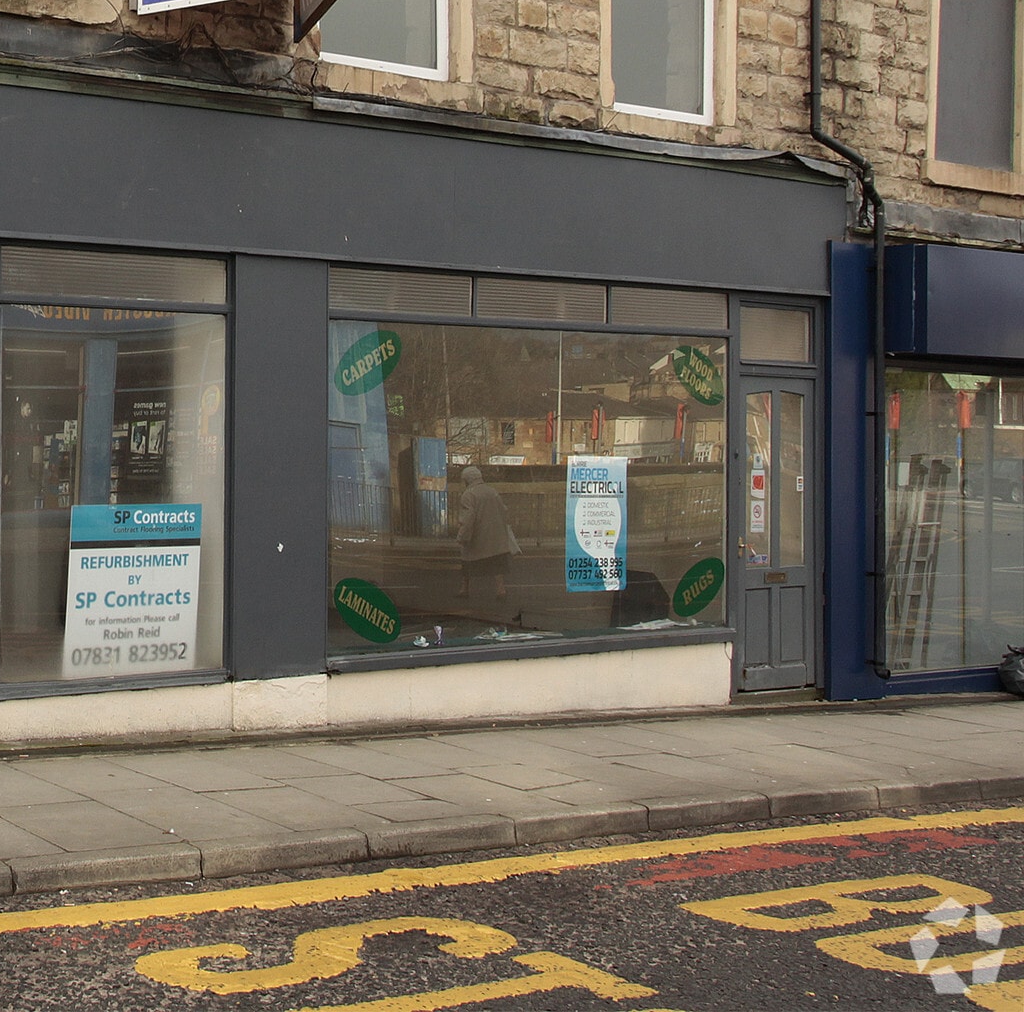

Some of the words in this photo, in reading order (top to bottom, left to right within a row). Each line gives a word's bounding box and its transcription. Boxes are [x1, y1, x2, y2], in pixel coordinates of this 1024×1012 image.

[342, 339, 396, 386] CARPETS
[689, 354, 713, 381] WOOD
[681, 365, 712, 399] FLOORS
[571, 468, 608, 481] MERCER
[114, 510, 131, 524] SP
[133, 509, 195, 524] Contracts
[141, 525, 164, 533] Flooring
[80, 554, 189, 569] REFURBISHMENT
[568, 558, 593, 569] 01254
[594, 557, 609, 568] 238
[128, 575, 142, 585] BY
[568, 569, 593, 580] 07737
[682, 569, 715, 606] RUGS
[75, 592, 97, 609] SP
[104, 589, 191, 608] Contracts
[338, 585, 396, 635] LAMINATES
[85, 618, 96, 626] for
[98, 616, 141, 625] information
[144, 614, 165, 623] Please
[168, 613, 180, 621] call
[103, 628, 133, 640] Robin
[138, 626, 161, 638] Reid
[71, 646, 120, 666] 07831
[128, 641, 188, 663] 823952
